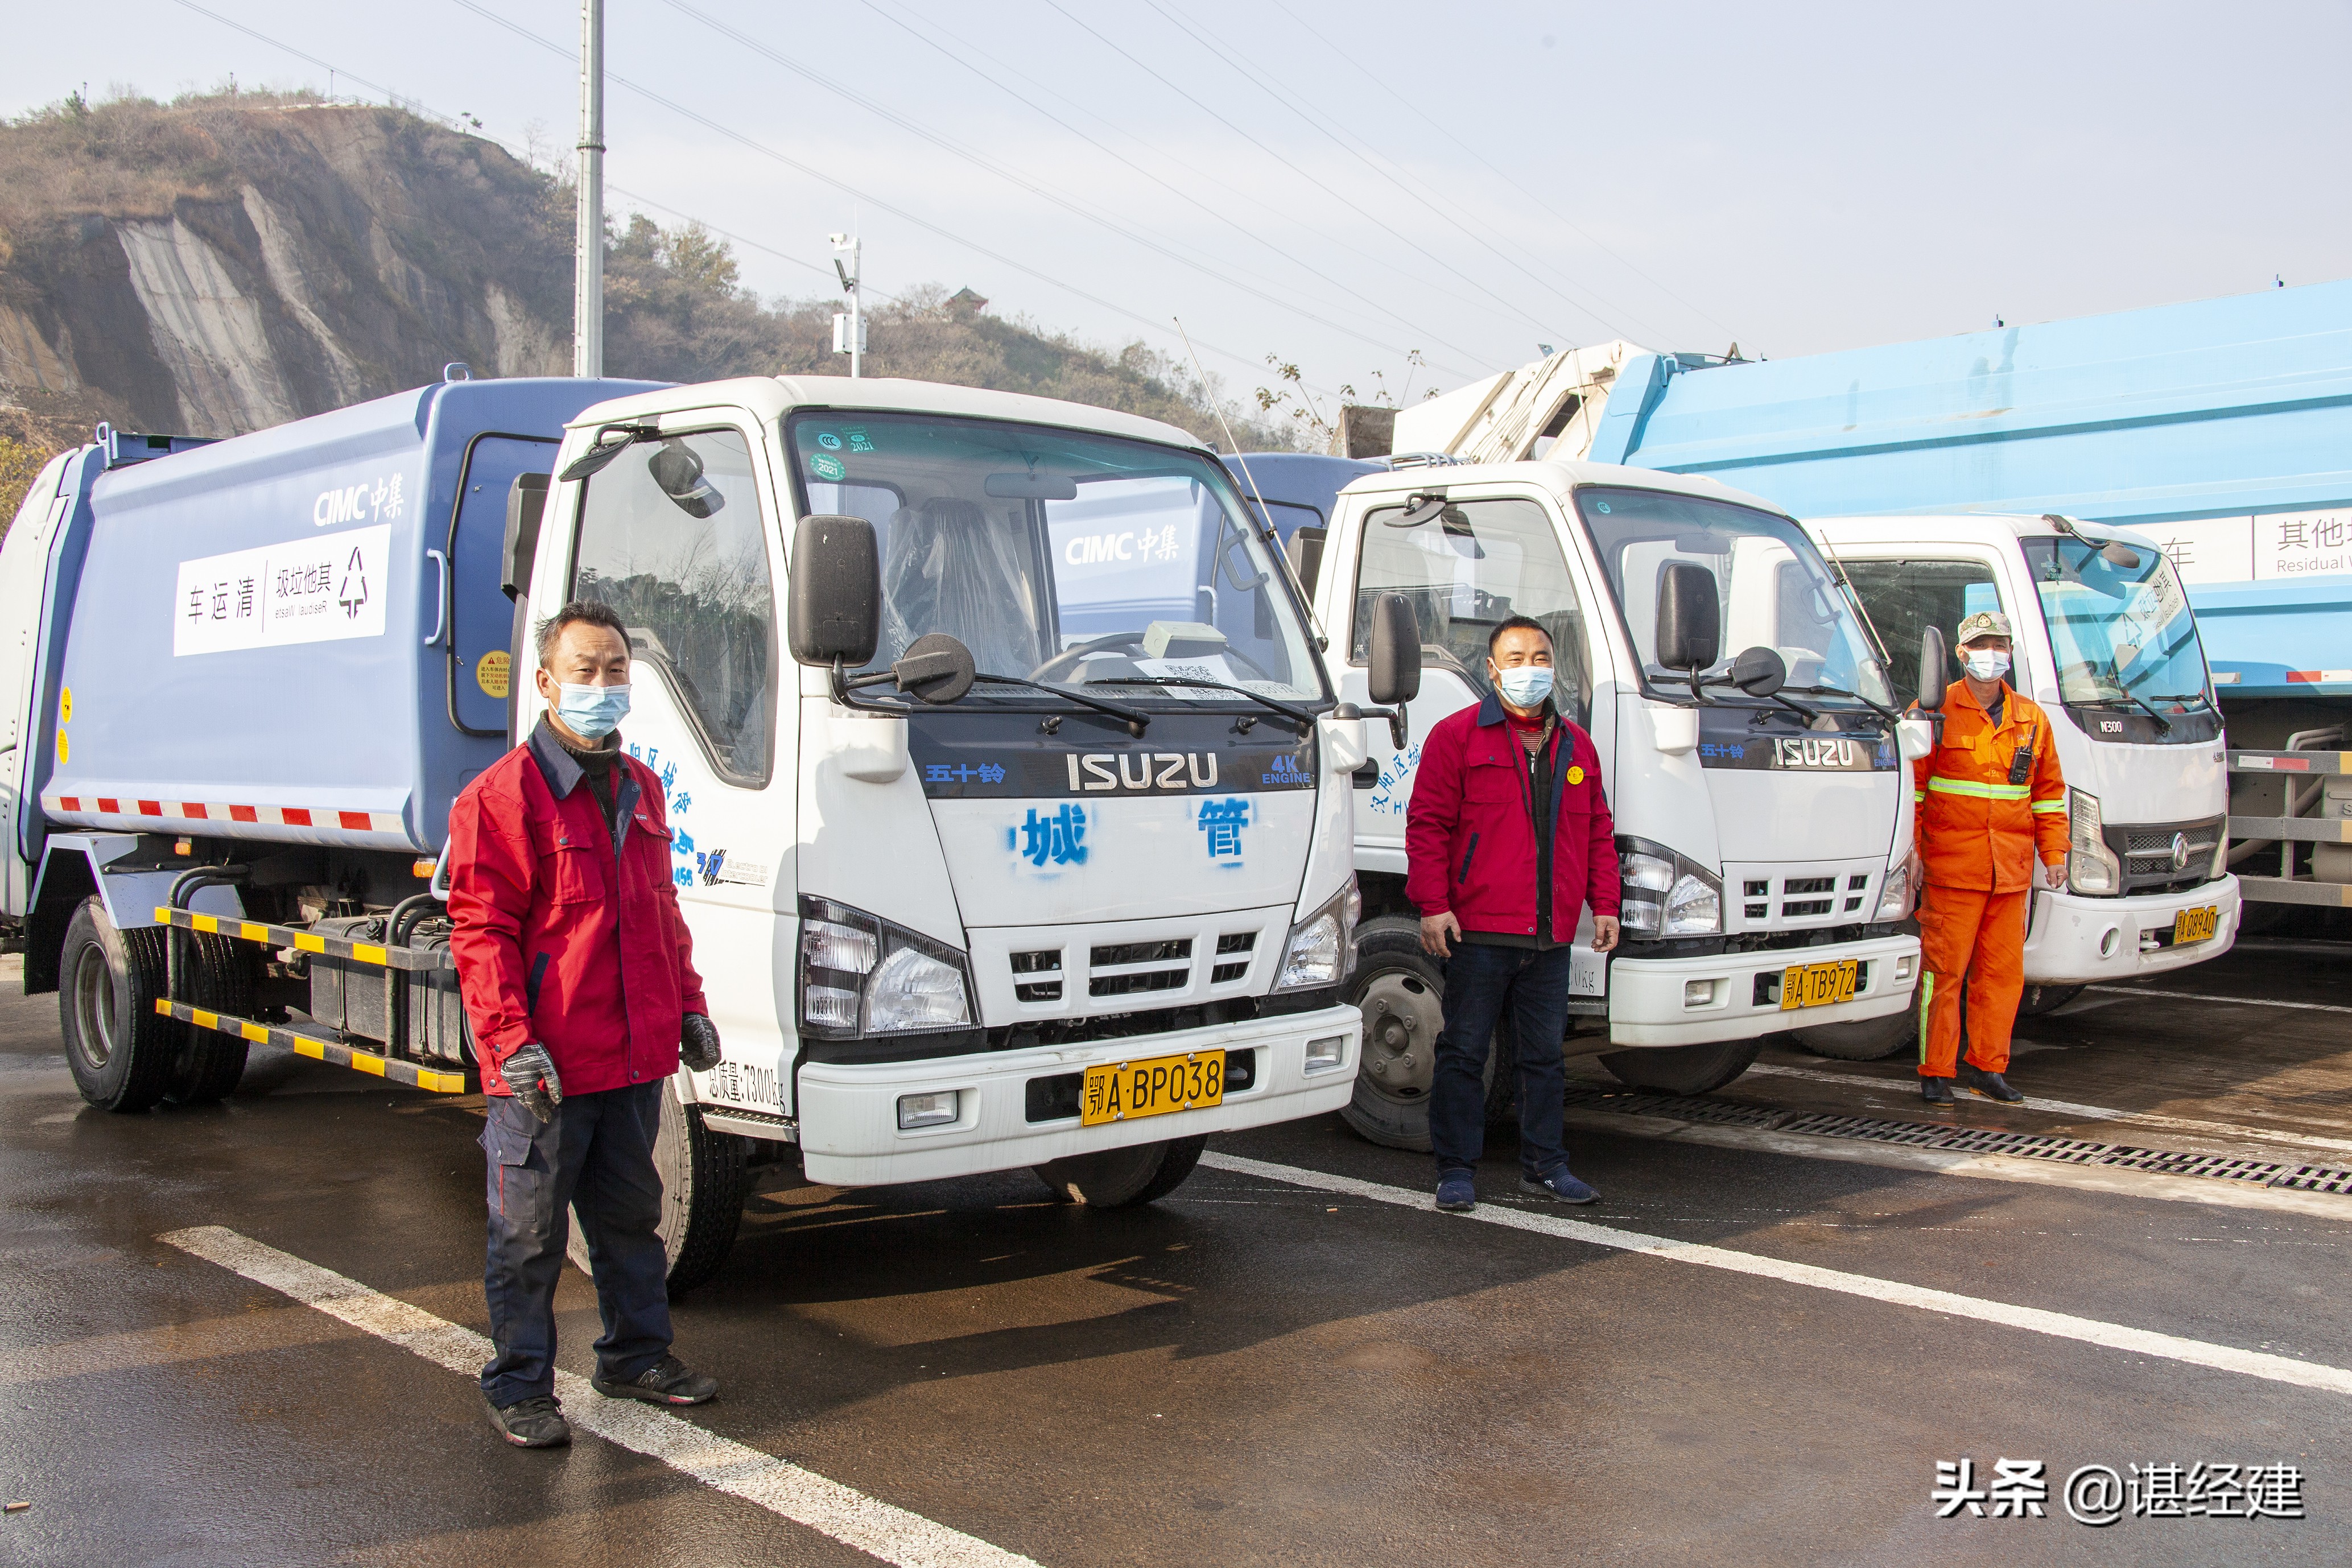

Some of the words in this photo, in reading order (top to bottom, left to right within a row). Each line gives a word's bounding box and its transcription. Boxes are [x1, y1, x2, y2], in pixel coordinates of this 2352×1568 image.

[851, 441, 875, 451] 2021
[818, 463, 838, 476] 2021
[314, 484, 369, 527] CIMC
[370, 472, 404, 523] 中集
[1065, 532, 1134, 565] CIMC
[1137, 525, 1179, 563] 中集
[2278, 517, 2352, 550] 其他
[2161, 537, 2195, 571] 车
[2277, 555, 2343, 572] Residual
[2100, 721, 2122, 732] N300
[1271, 754, 1298, 774] 4K
[1701, 743, 1744, 760] 五十铃
[1775, 738, 1853, 766] ISUZU
[925, 762, 1006, 784] 五十铃
[1066, 752, 1219, 791] ISUZU
[1262, 771, 1311, 785] ENGINE
[696, 852, 724, 876] 3.0
